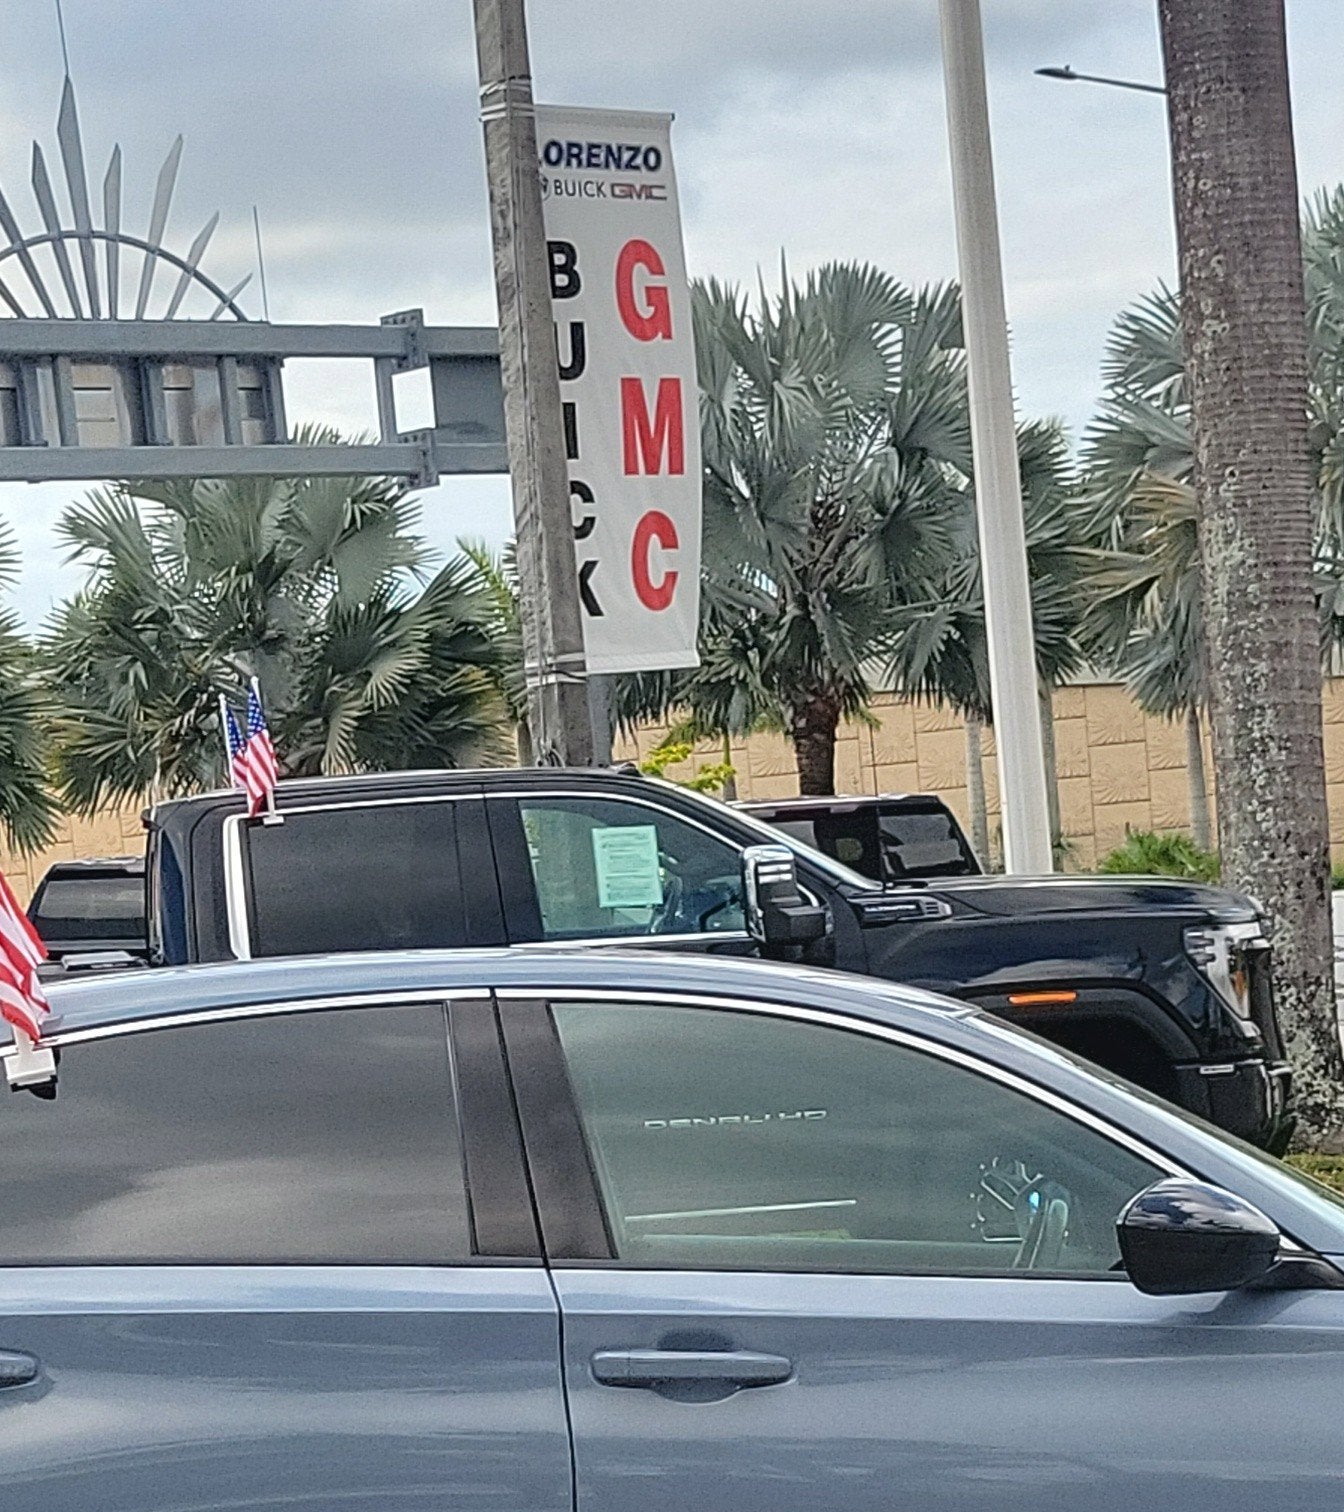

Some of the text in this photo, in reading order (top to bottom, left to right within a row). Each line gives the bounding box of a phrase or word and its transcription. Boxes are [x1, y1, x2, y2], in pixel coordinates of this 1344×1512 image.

[537, 139, 662, 172] ORENZO
[553, 179, 668, 200] BUICK GMC
[615, 239, 684, 611] GMC
